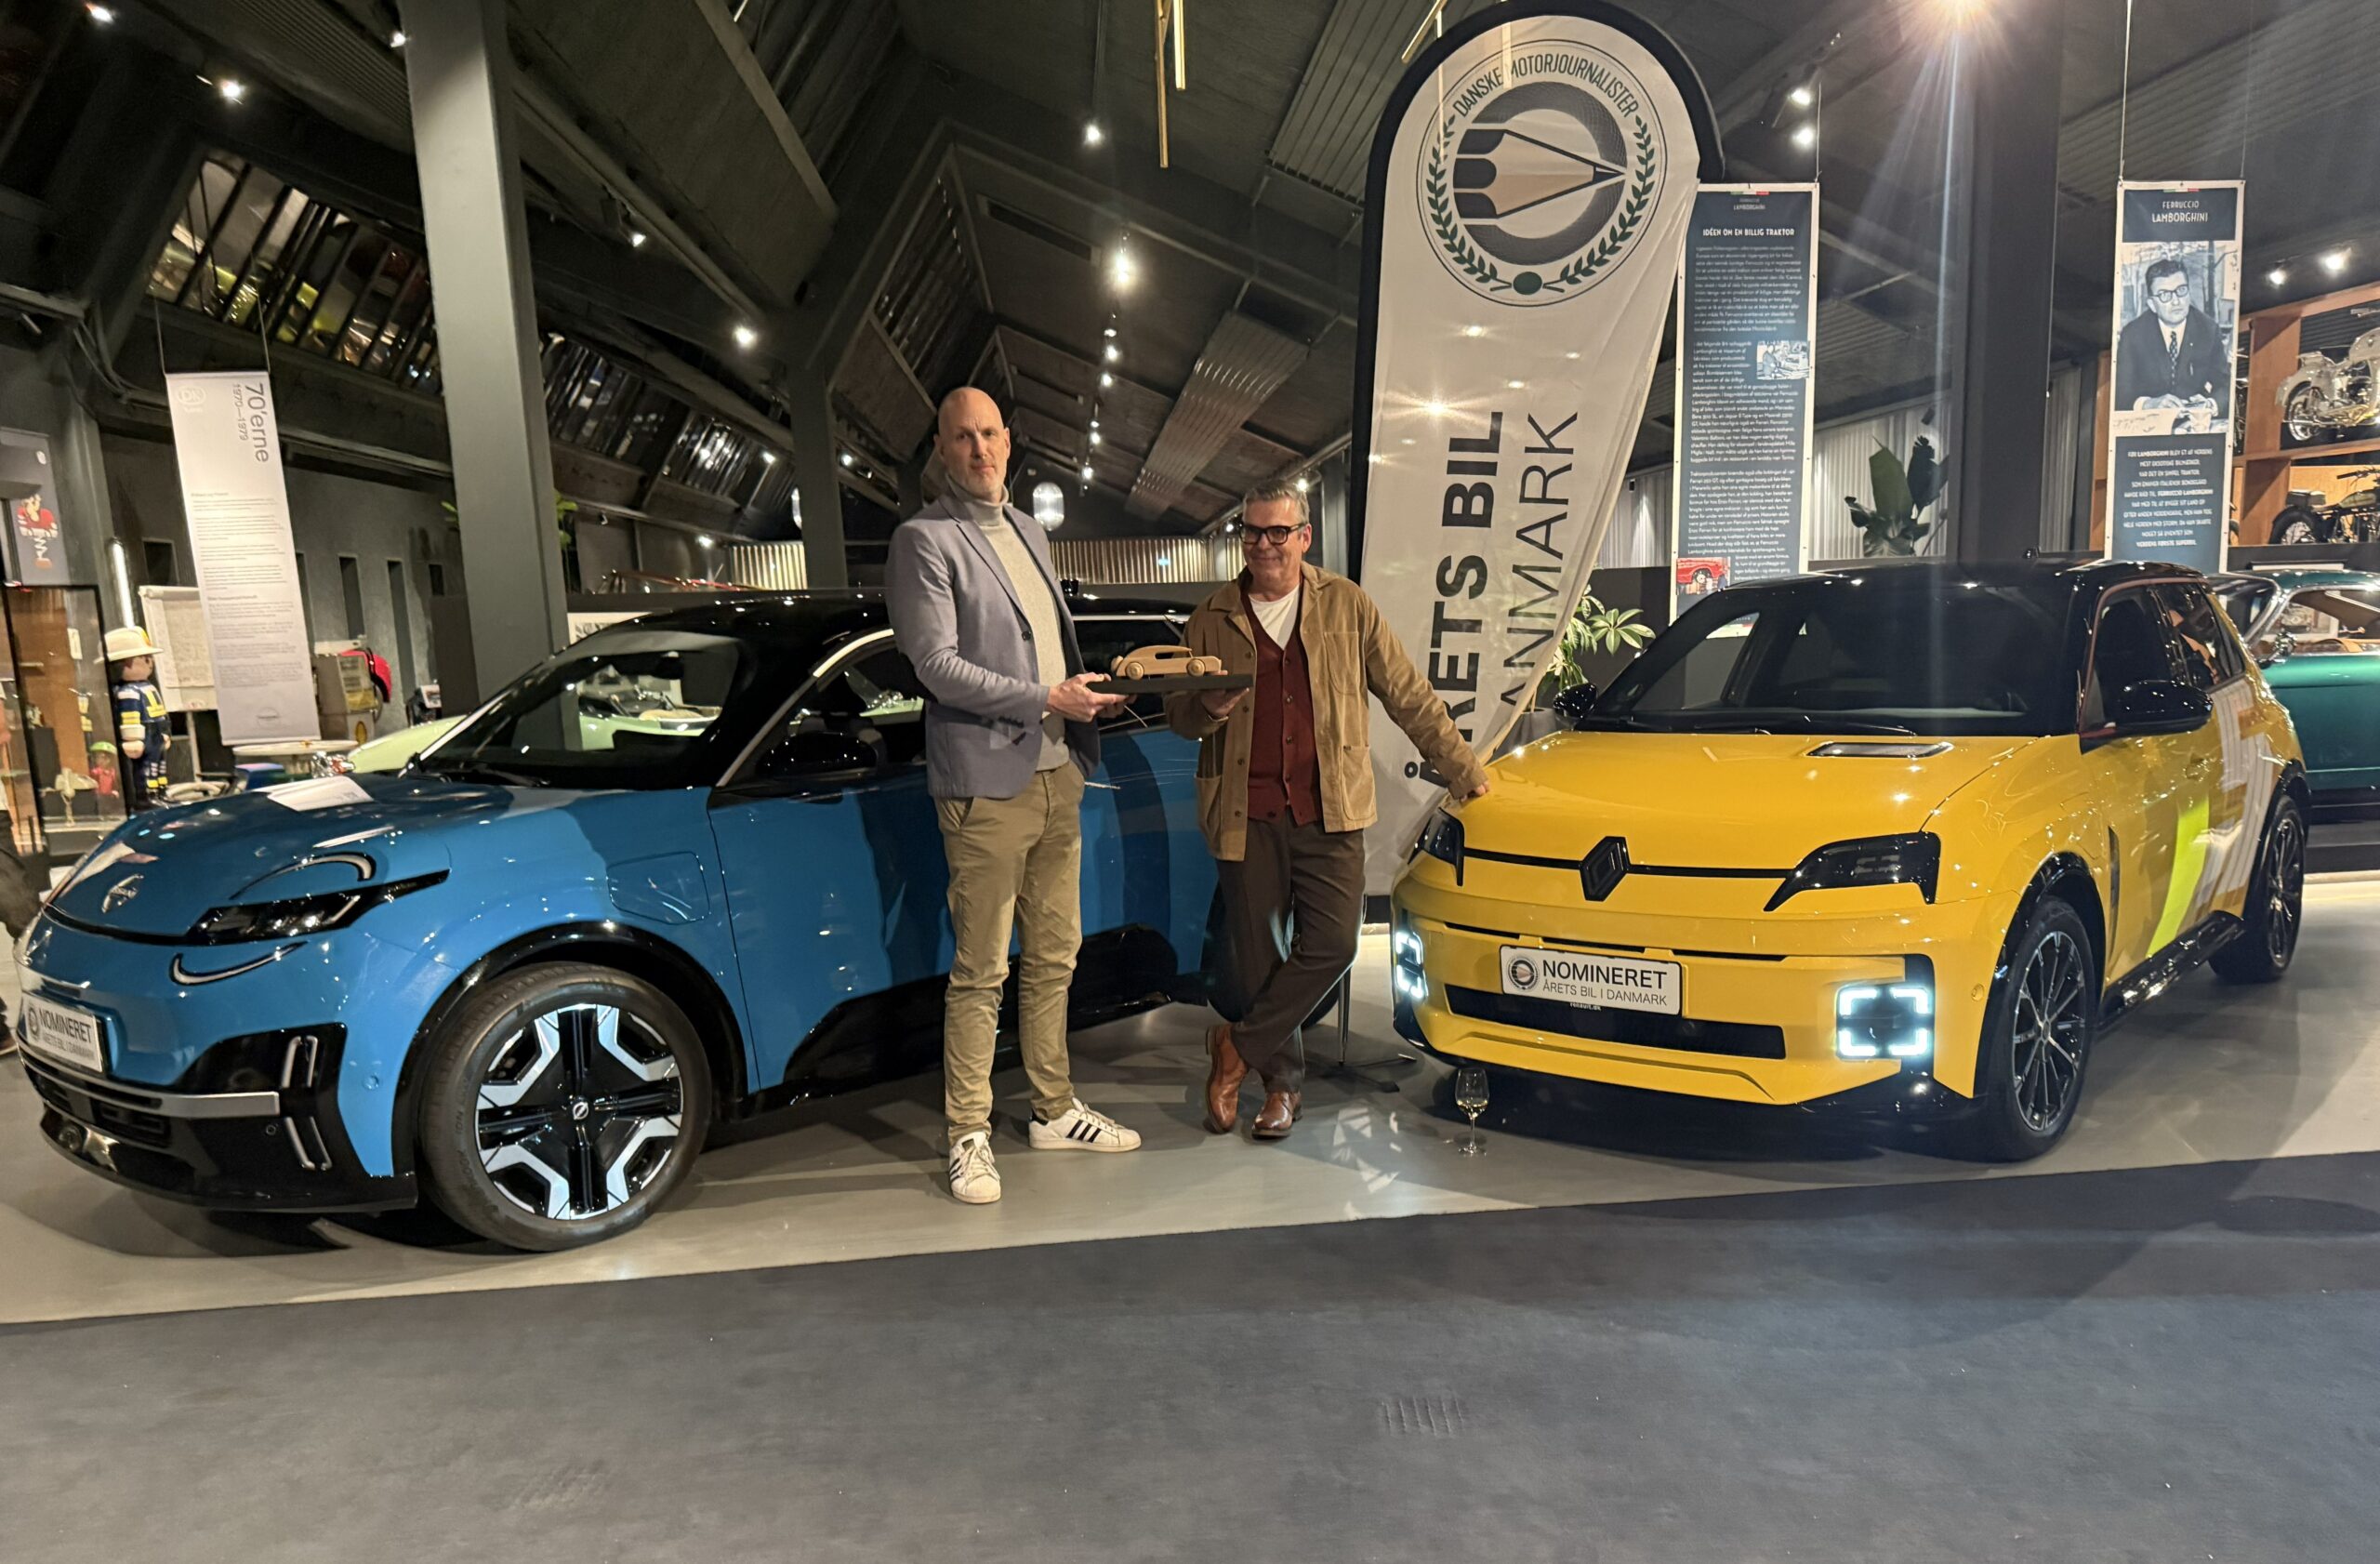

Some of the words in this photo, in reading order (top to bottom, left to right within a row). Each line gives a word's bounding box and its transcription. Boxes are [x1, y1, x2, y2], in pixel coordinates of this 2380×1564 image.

[1452, 67, 1503, 117] DANSKE
[1507, 53, 1639, 117] MOTORJOURNALISTER
[2151, 212, 2209, 223] LAMBORGHINI
[2162, 200, 2200, 209] FERRUCCIO
[1765, 228, 1795, 236] TRAKTOR
[1442, 411, 1503, 528] BIL
[1501, 412, 1578, 707] ANMARK
[1542, 960, 1667, 989] NOMINERET
[1542, 979, 1577, 996] ÅRETS
[1580, 987, 1596, 999] BIL
[1600, 988, 1604, 999] I
[1606, 989, 1667, 1005] DANMARK
[39, 1008, 91, 1043] NOMINERET
